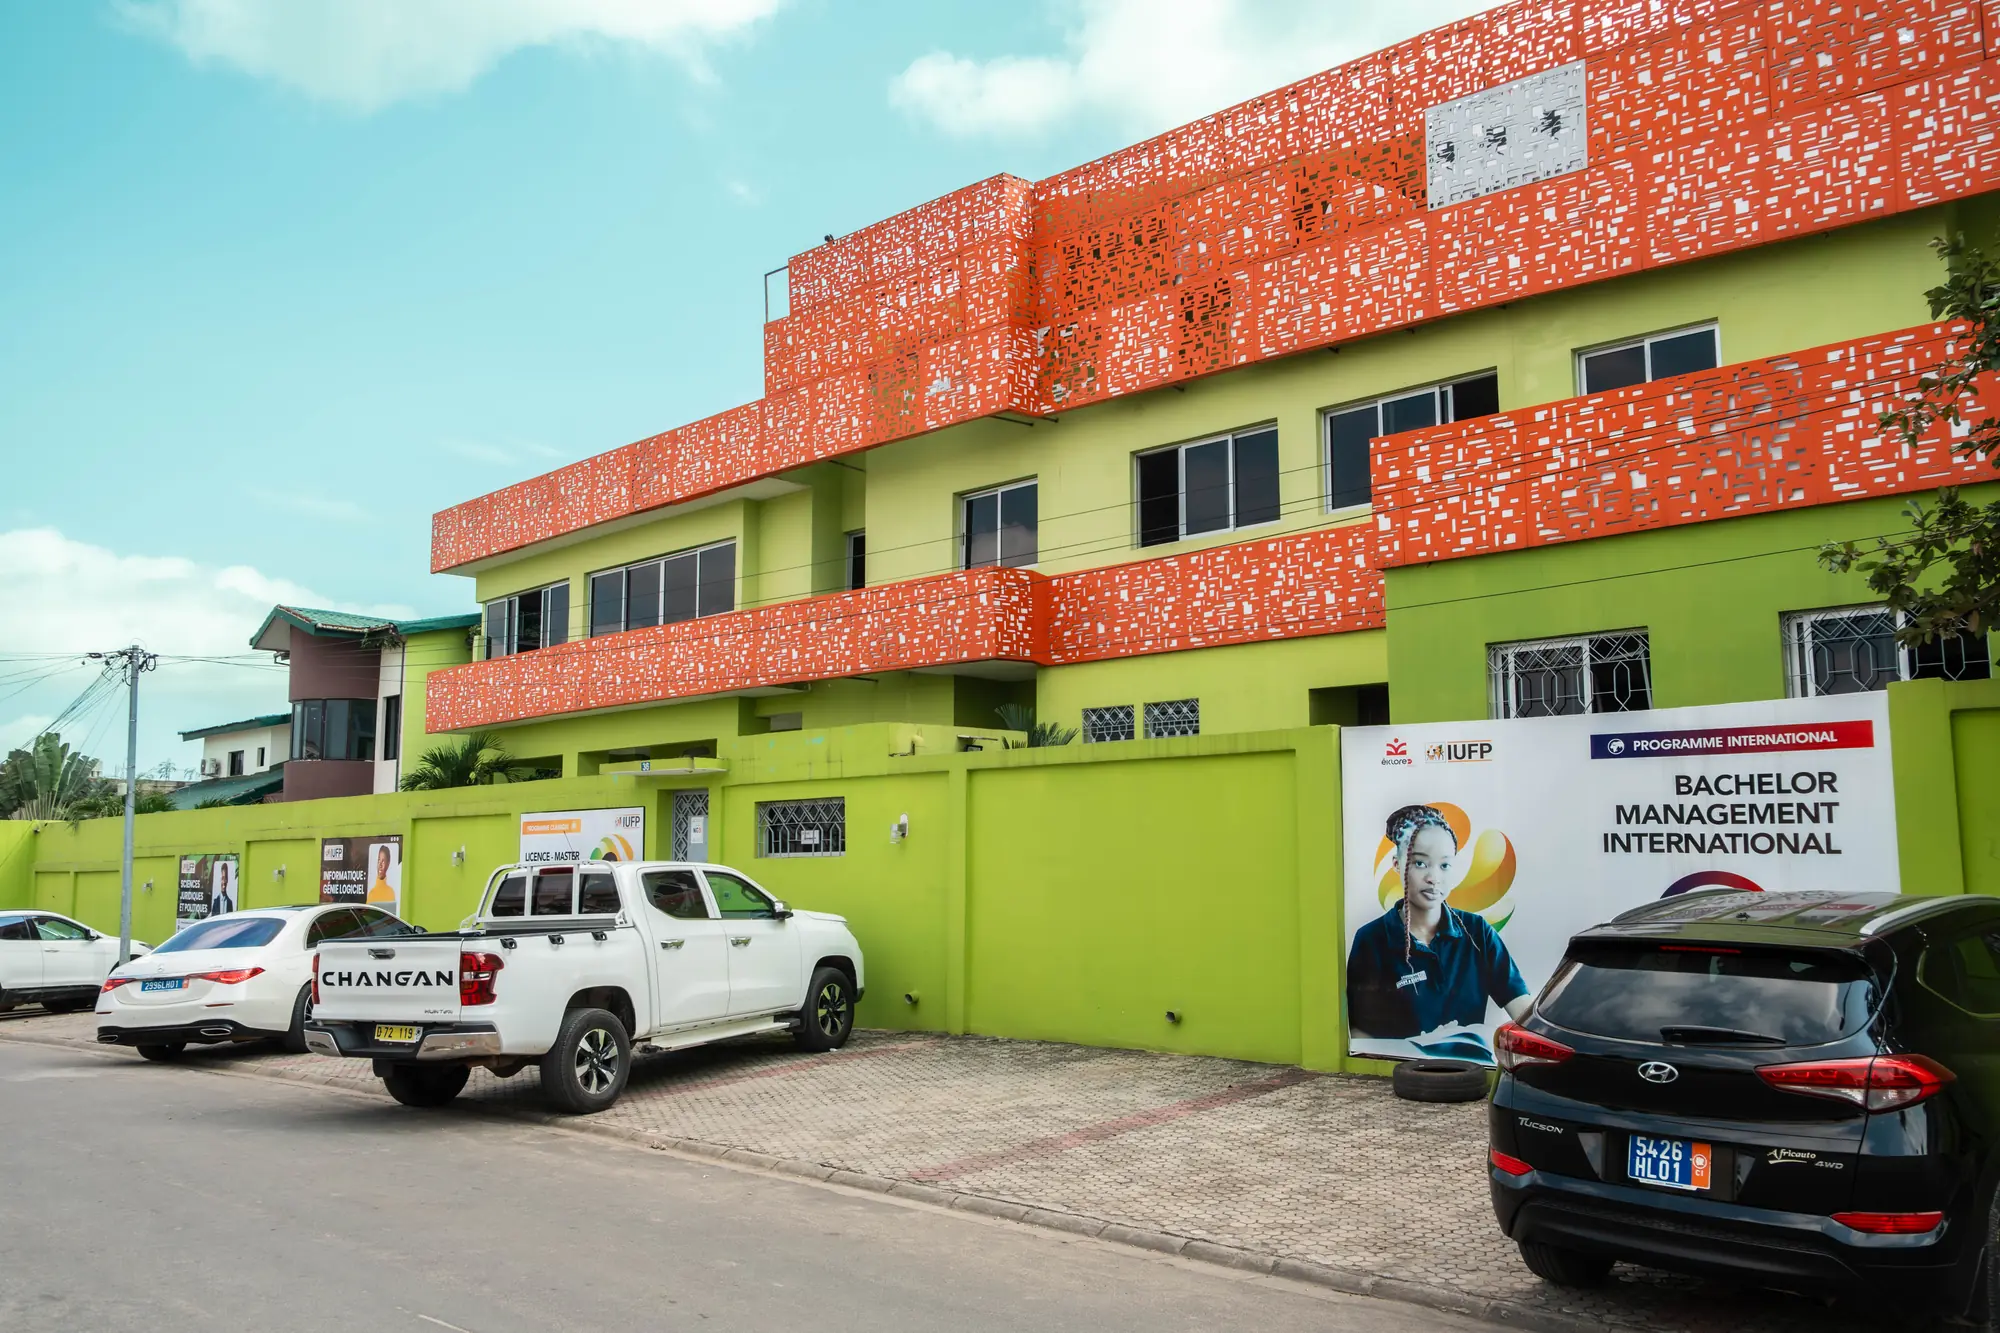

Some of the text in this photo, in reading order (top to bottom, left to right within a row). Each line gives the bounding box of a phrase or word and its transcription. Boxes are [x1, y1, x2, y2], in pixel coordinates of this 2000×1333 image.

[1633, 731, 1838, 751] PROGRAMME INTERNATIONAL
[1447, 743, 1492, 760] IUFP
[1675, 771, 1838, 796] BACHELOR
[1615, 802, 1840, 825] MANAGEMENT
[623, 816, 640, 828] IUFP
[1603, 832, 1842, 855] INTERNATIONAL
[525, 851, 550, 862] LICENCE
[180, 880, 200, 888] SCIENCES
[323, 881, 364, 894] GÉNIE LOGICIEL
[185, 903, 208, 913] POLITIQUES
[322, 971, 453, 987] CHANGAN
[1636, 1136, 1683, 1161] 5426
[1767, 1148, 1816, 1160] Africauto
[1635, 1156, 1680, 1183] HL01
[1814, 1160, 1844, 1170] 4WD
[1695, 1169, 1704, 1177] CI
